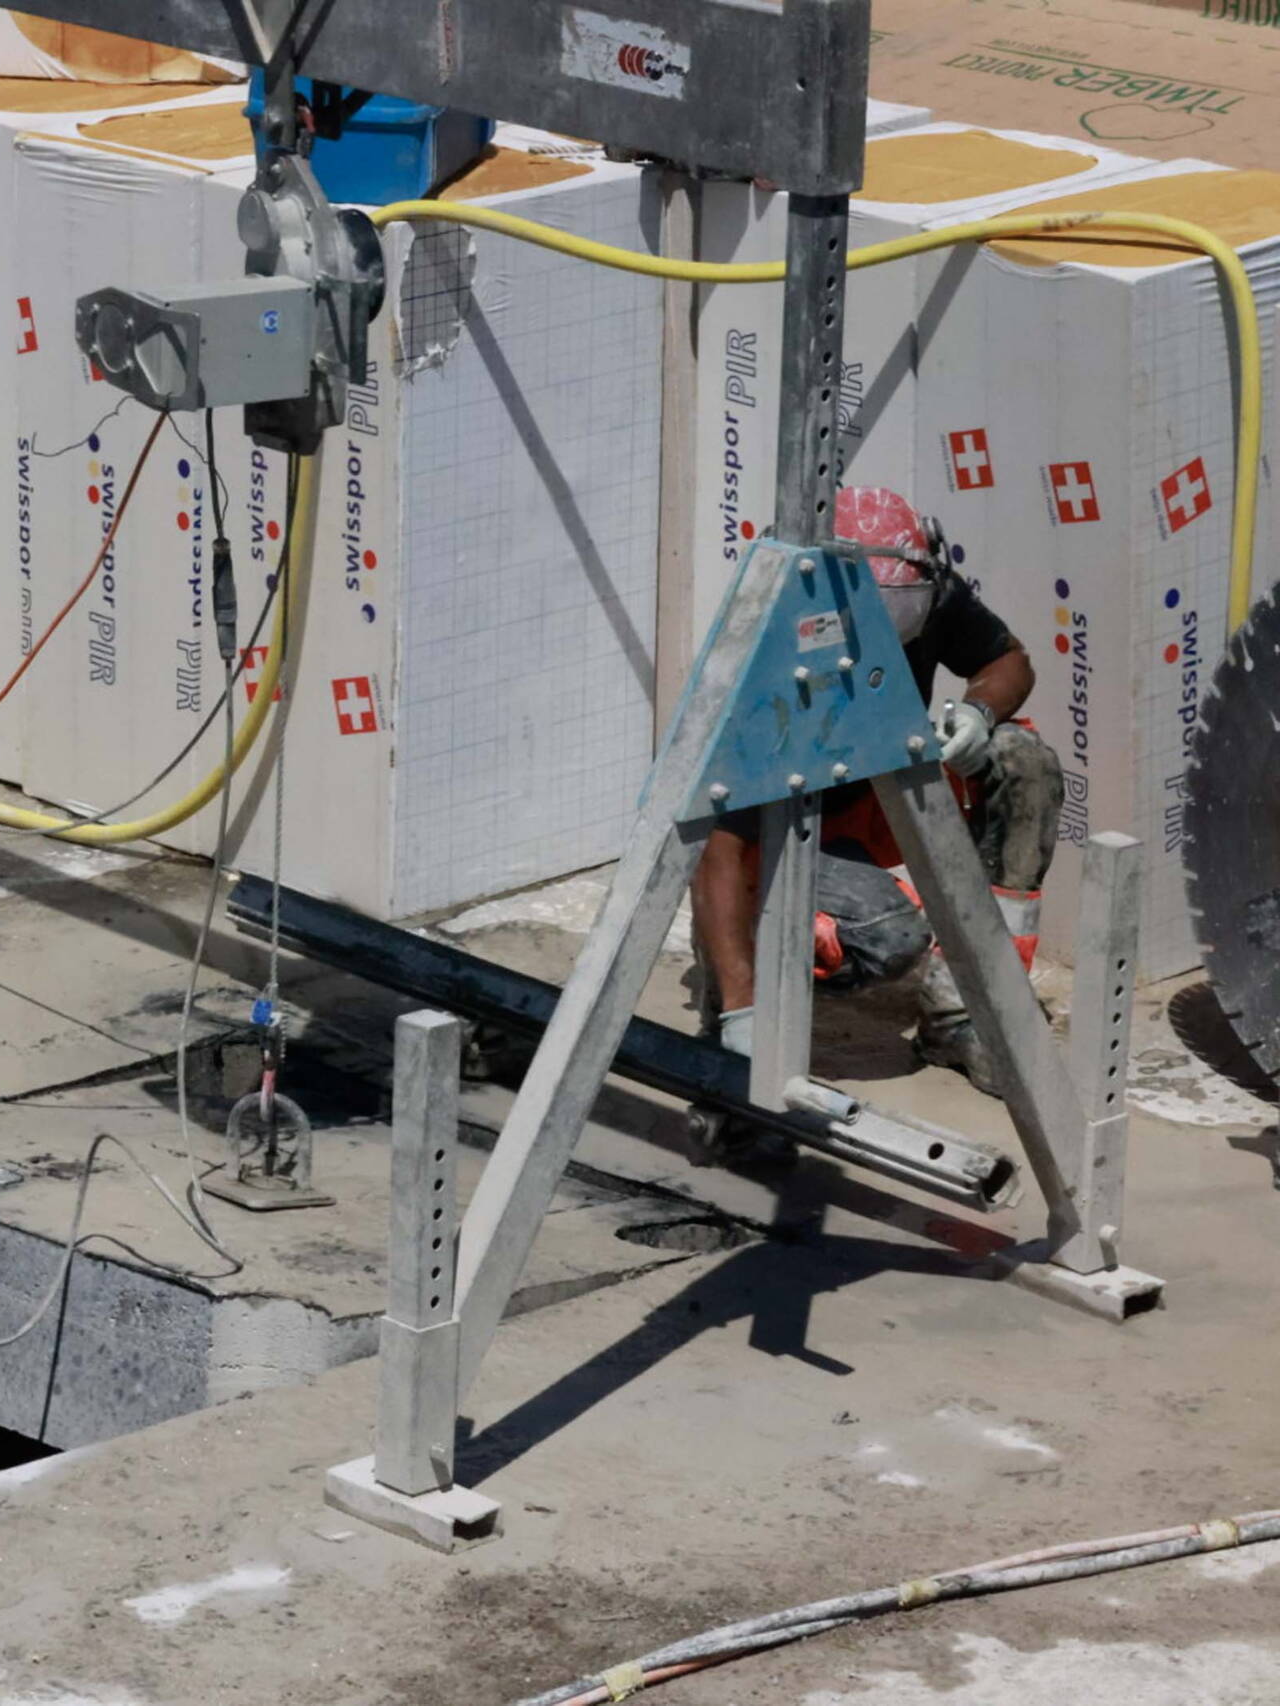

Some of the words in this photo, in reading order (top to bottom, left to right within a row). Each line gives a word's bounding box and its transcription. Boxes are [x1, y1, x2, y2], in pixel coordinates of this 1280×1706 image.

[1054, 66, 1245, 115] TIMBER
[726, 329, 757, 409] PIR
[248, 444, 269, 562] swissp
[342, 440, 367, 591] swisspor
[720, 410, 742, 561] swisspor
[88, 610, 116, 686] PIR
[1067, 611, 1091, 767] swisspor
